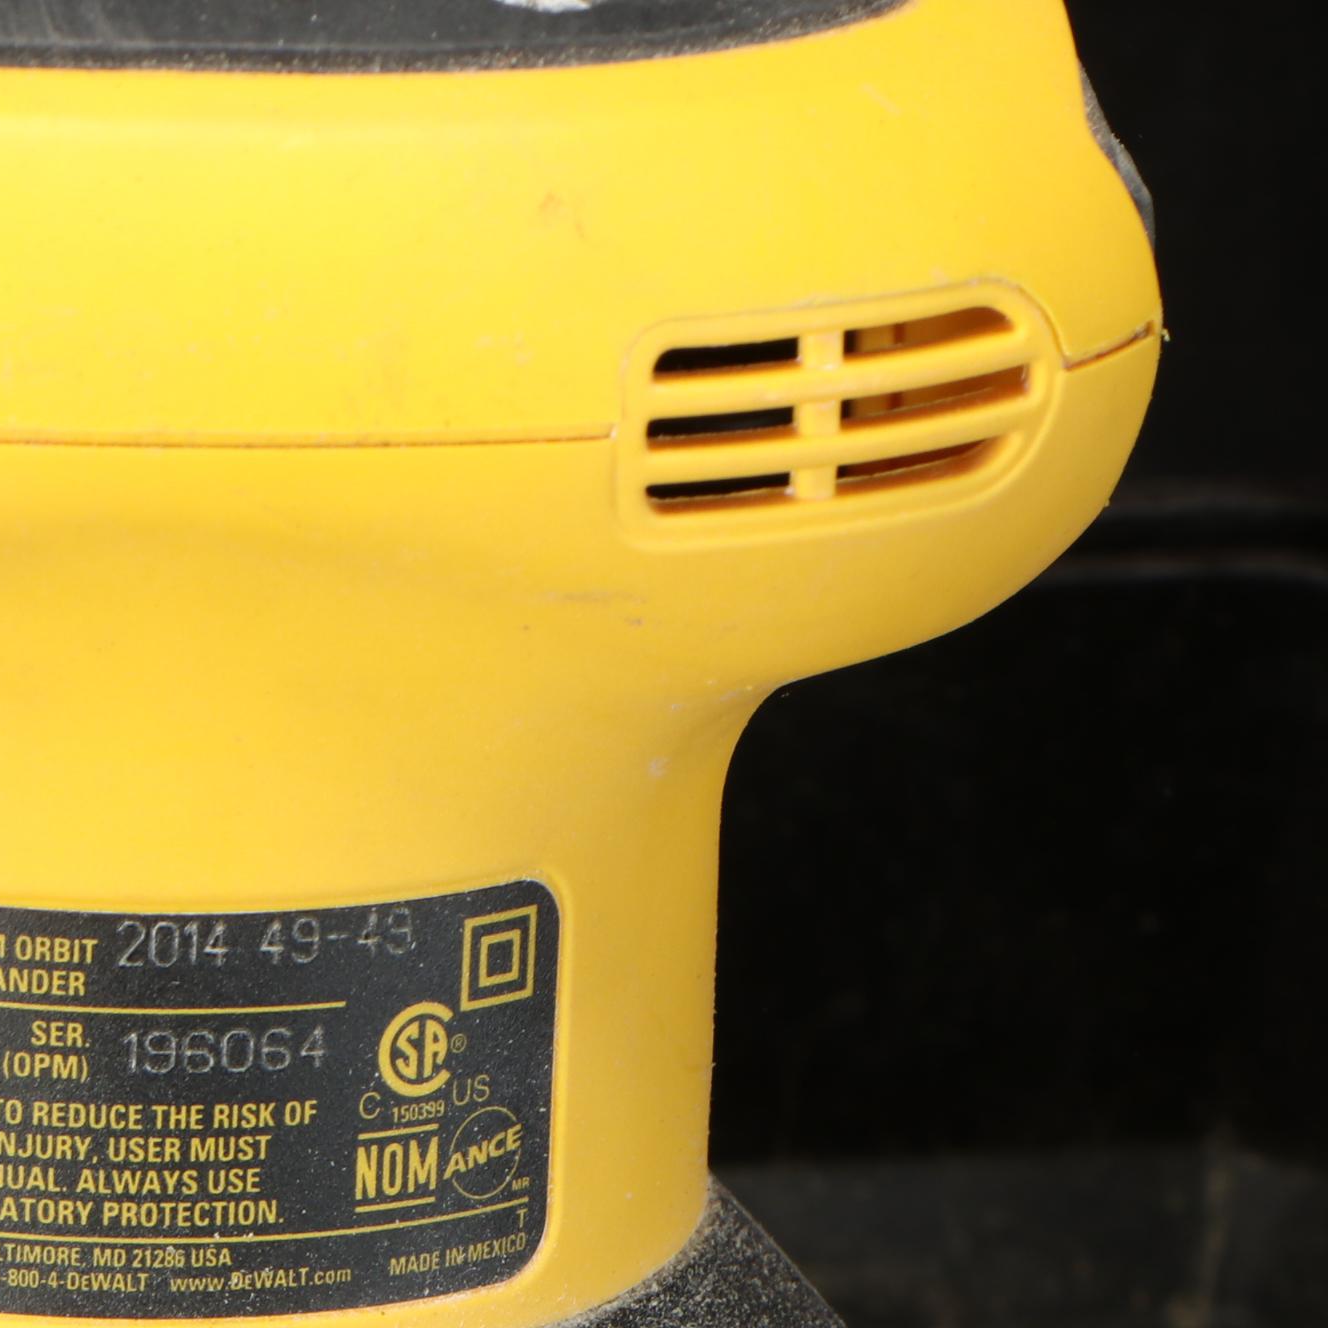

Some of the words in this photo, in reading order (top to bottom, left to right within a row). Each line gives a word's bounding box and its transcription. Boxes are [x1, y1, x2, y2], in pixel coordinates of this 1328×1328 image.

[15, 935, 99, 965] ORBIT
[115, 919, 230, 968] 2014
[31, 1020, 91, 1048] SER.
[3, 1050, 89, 1083] (OPM)
[452, 1074, 490, 1106] US
[33, 1100, 143, 1131] REDUCE
[152, 1104, 203, 1131] THE
[213, 1101, 275, 1129] RISK
[284, 1099, 318, 1126] OF
[392, 1099, 445, 1124] 150399
[108, 1136, 180, 1163] USER
[190, 1134, 272, 1162] MUST
[443, 1123, 523, 1180] ANCE
[77, 1168, 198, 1195] ALWAYS
[207, 1167, 261, 1193] USE
[355, 1136, 439, 1200] NOM
[512, 1177, 530, 1191] MR
[102, 1200, 285, 1228] PROTECTION.
[516, 1208, 528, 1228] T
[93, 1248, 127, 1267] MD
[132, 1248, 185, 1268] 21286
[191, 1247, 232, 1267] USA
[389, 1252, 441, 1276] MADE
[445, 1247, 463, 1267] IN
[468, 1233, 526, 1260] MEXICO
